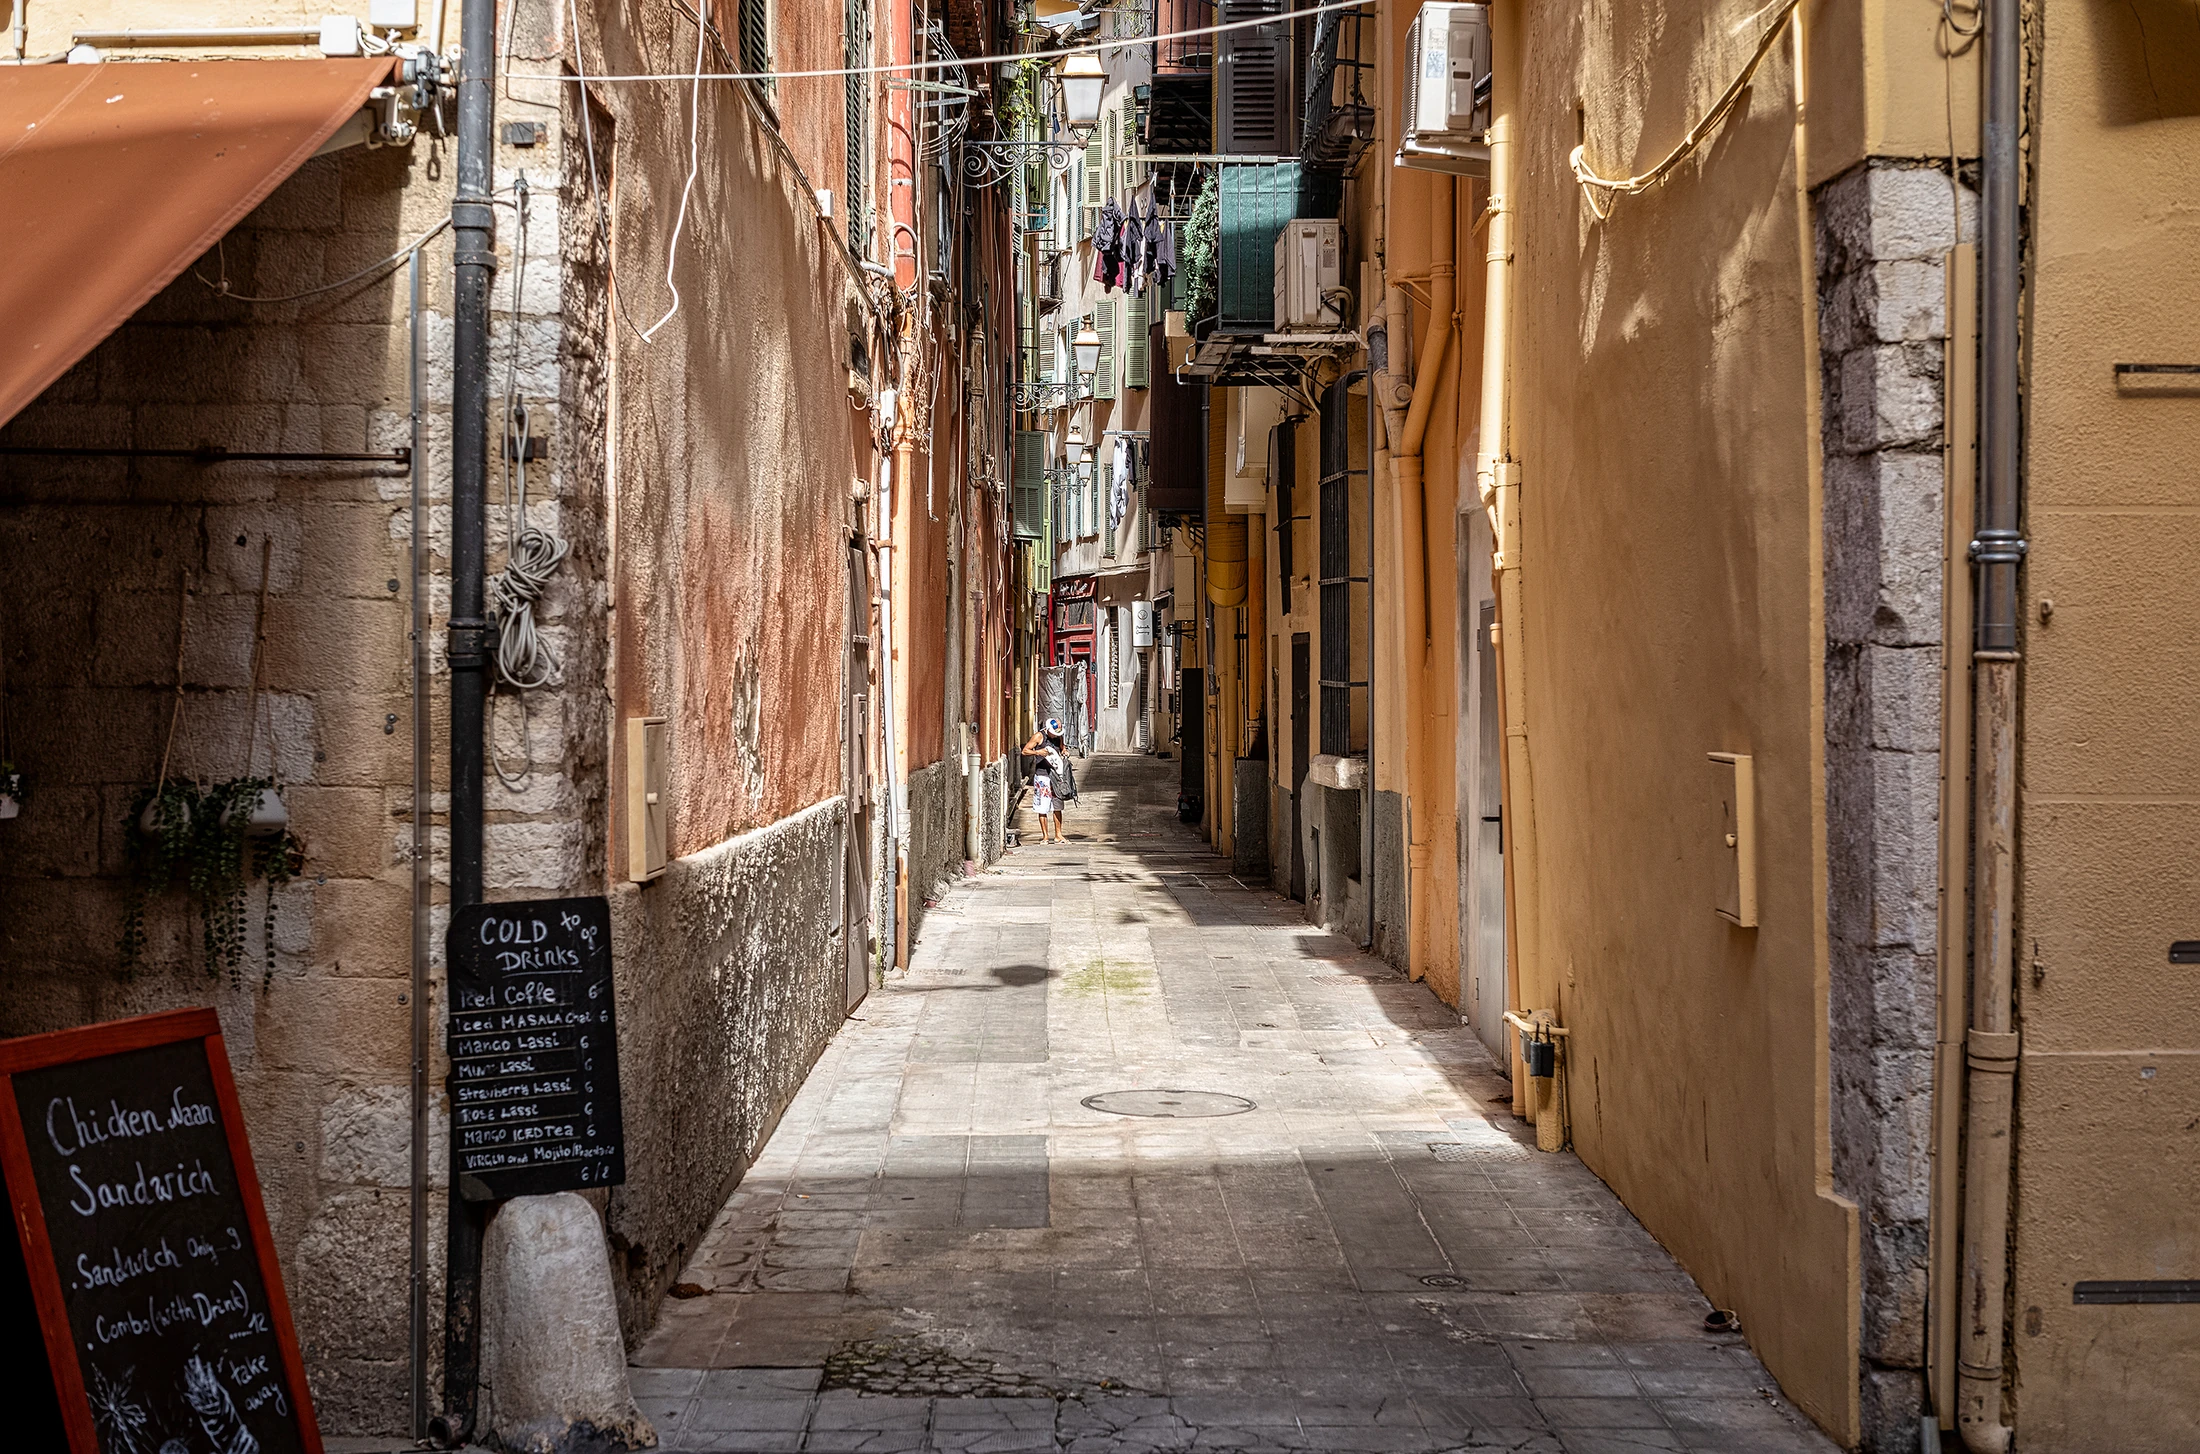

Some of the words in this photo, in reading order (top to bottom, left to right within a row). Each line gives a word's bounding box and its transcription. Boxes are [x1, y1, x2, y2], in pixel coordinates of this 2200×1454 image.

[480, 917, 548, 945] COLD
[560, 910, 581, 931] to
[460, 986, 496, 1008] Iced
[504, 981, 557, 1004] Coffe
[588, 984, 600, 999] 6
[456, 1015, 494, 1032] Iced
[501, 1013, 563, 1030] MASALA
[600, 1009, 609, 1023] 6
[517, 1031, 561, 1049] Lassi
[579, 1035, 590, 1049] 6
[499, 1056, 536, 1074] Lassi
[584, 1057, 594, 1072] 6
[533, 1077, 573, 1095] Lassi
[584, 1080, 594, 1094] 6
[46, 1096, 164, 1156] Chicken
[167, 1085, 217, 1129] Naan
[583, 1101, 594, 1116] 6
[544, 1124, 575, 1138] Tea
[586, 1124, 597, 1137] 6
[69, 1158, 221, 1217] Sandwich
[76, 1236, 182, 1289] Sandwich
[229, 1354, 269, 1386] take
[244, 1382, 288, 1417] away
